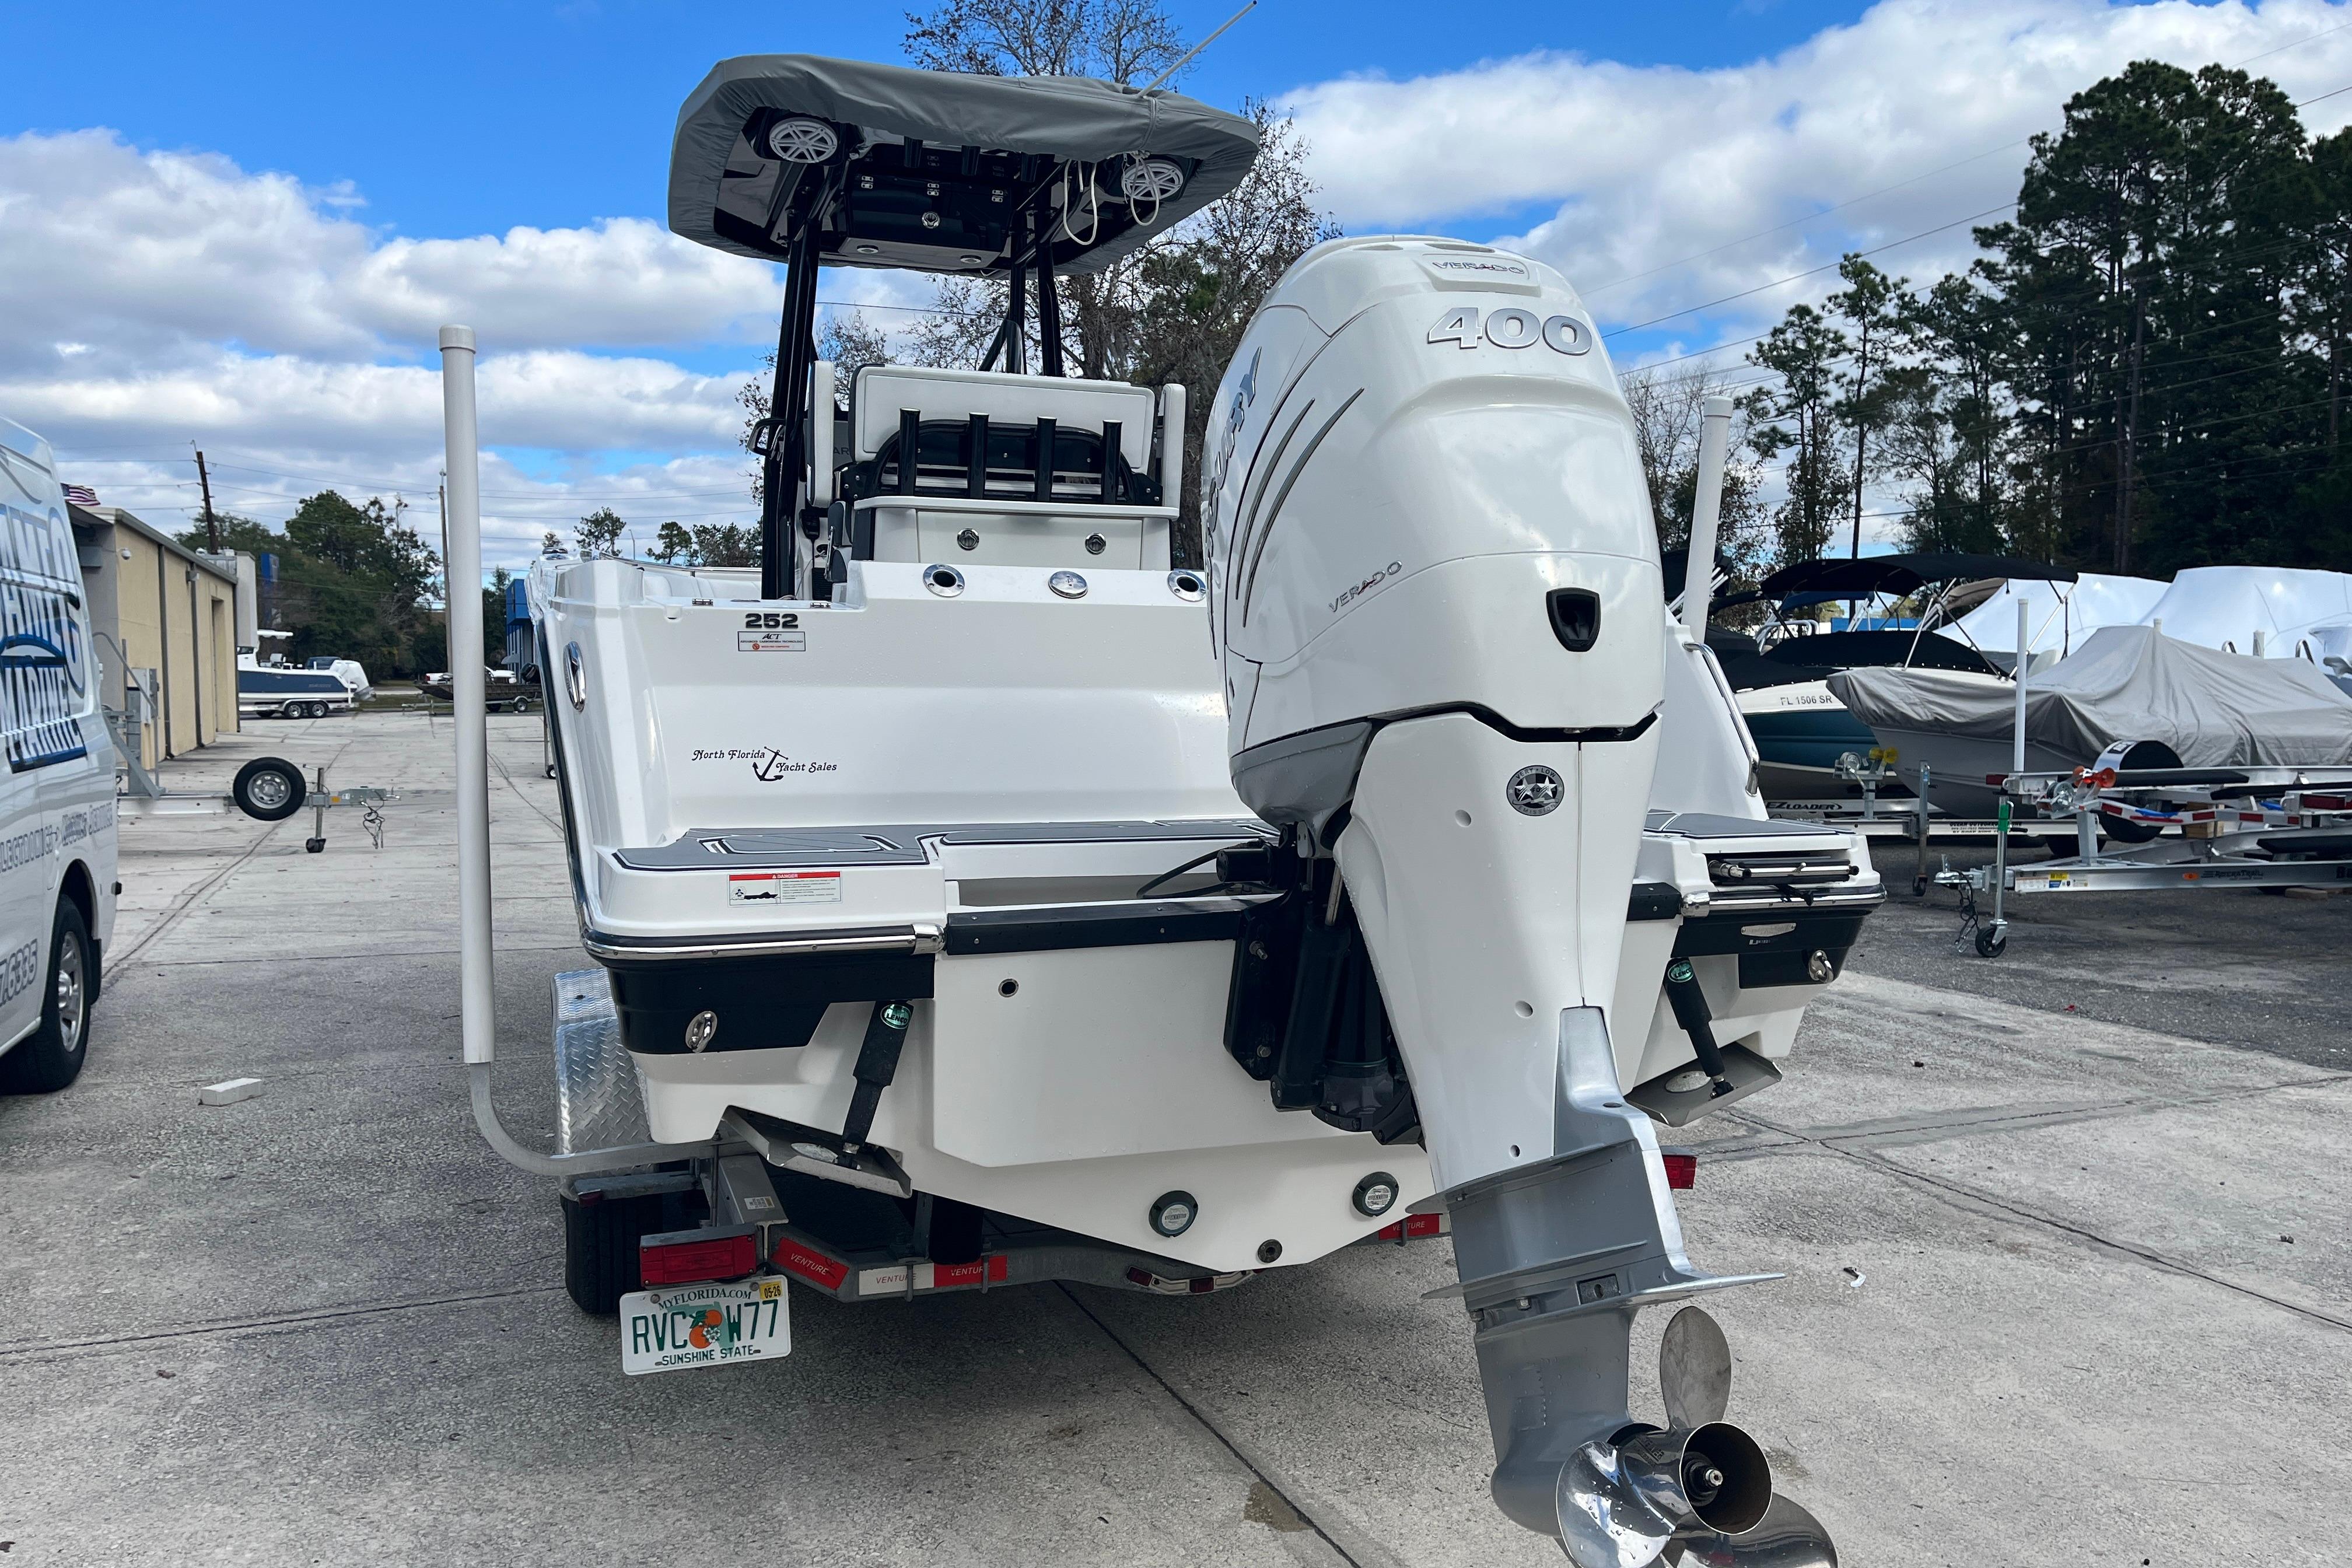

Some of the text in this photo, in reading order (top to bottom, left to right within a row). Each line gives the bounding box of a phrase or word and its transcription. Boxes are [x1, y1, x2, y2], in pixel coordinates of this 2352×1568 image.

[1433, 262, 1525, 274] VERADO
[1427, 307, 1592, 356] 400
[1328, 560, 1402, 612] VERADO
[746, 613, 799, 629] 252
[1780, 695, 1833, 706] FL 1506 SR
[692, 750, 765, 761] North Florida
[776, 762, 837, 773] Yacht Sales
[1515, 768, 1556, 779] VERY LOW
[1517, 803, 1556, 815] EMISSION
[1766, 801, 1835, 810] EZLOADER
[886, 1012, 908, 1024] LENCO
[1392, 1221, 1426, 1231] VETURE
[790, 1252, 829, 1276] VENTURE
[951, 1266, 984, 1276] VENTUR
[658, 1287, 752, 1311] MYFLORIDA.COM
[632, 1298, 779, 1354] RVC W77
[662, 1345, 754, 1366] SUNSHINE STATE
